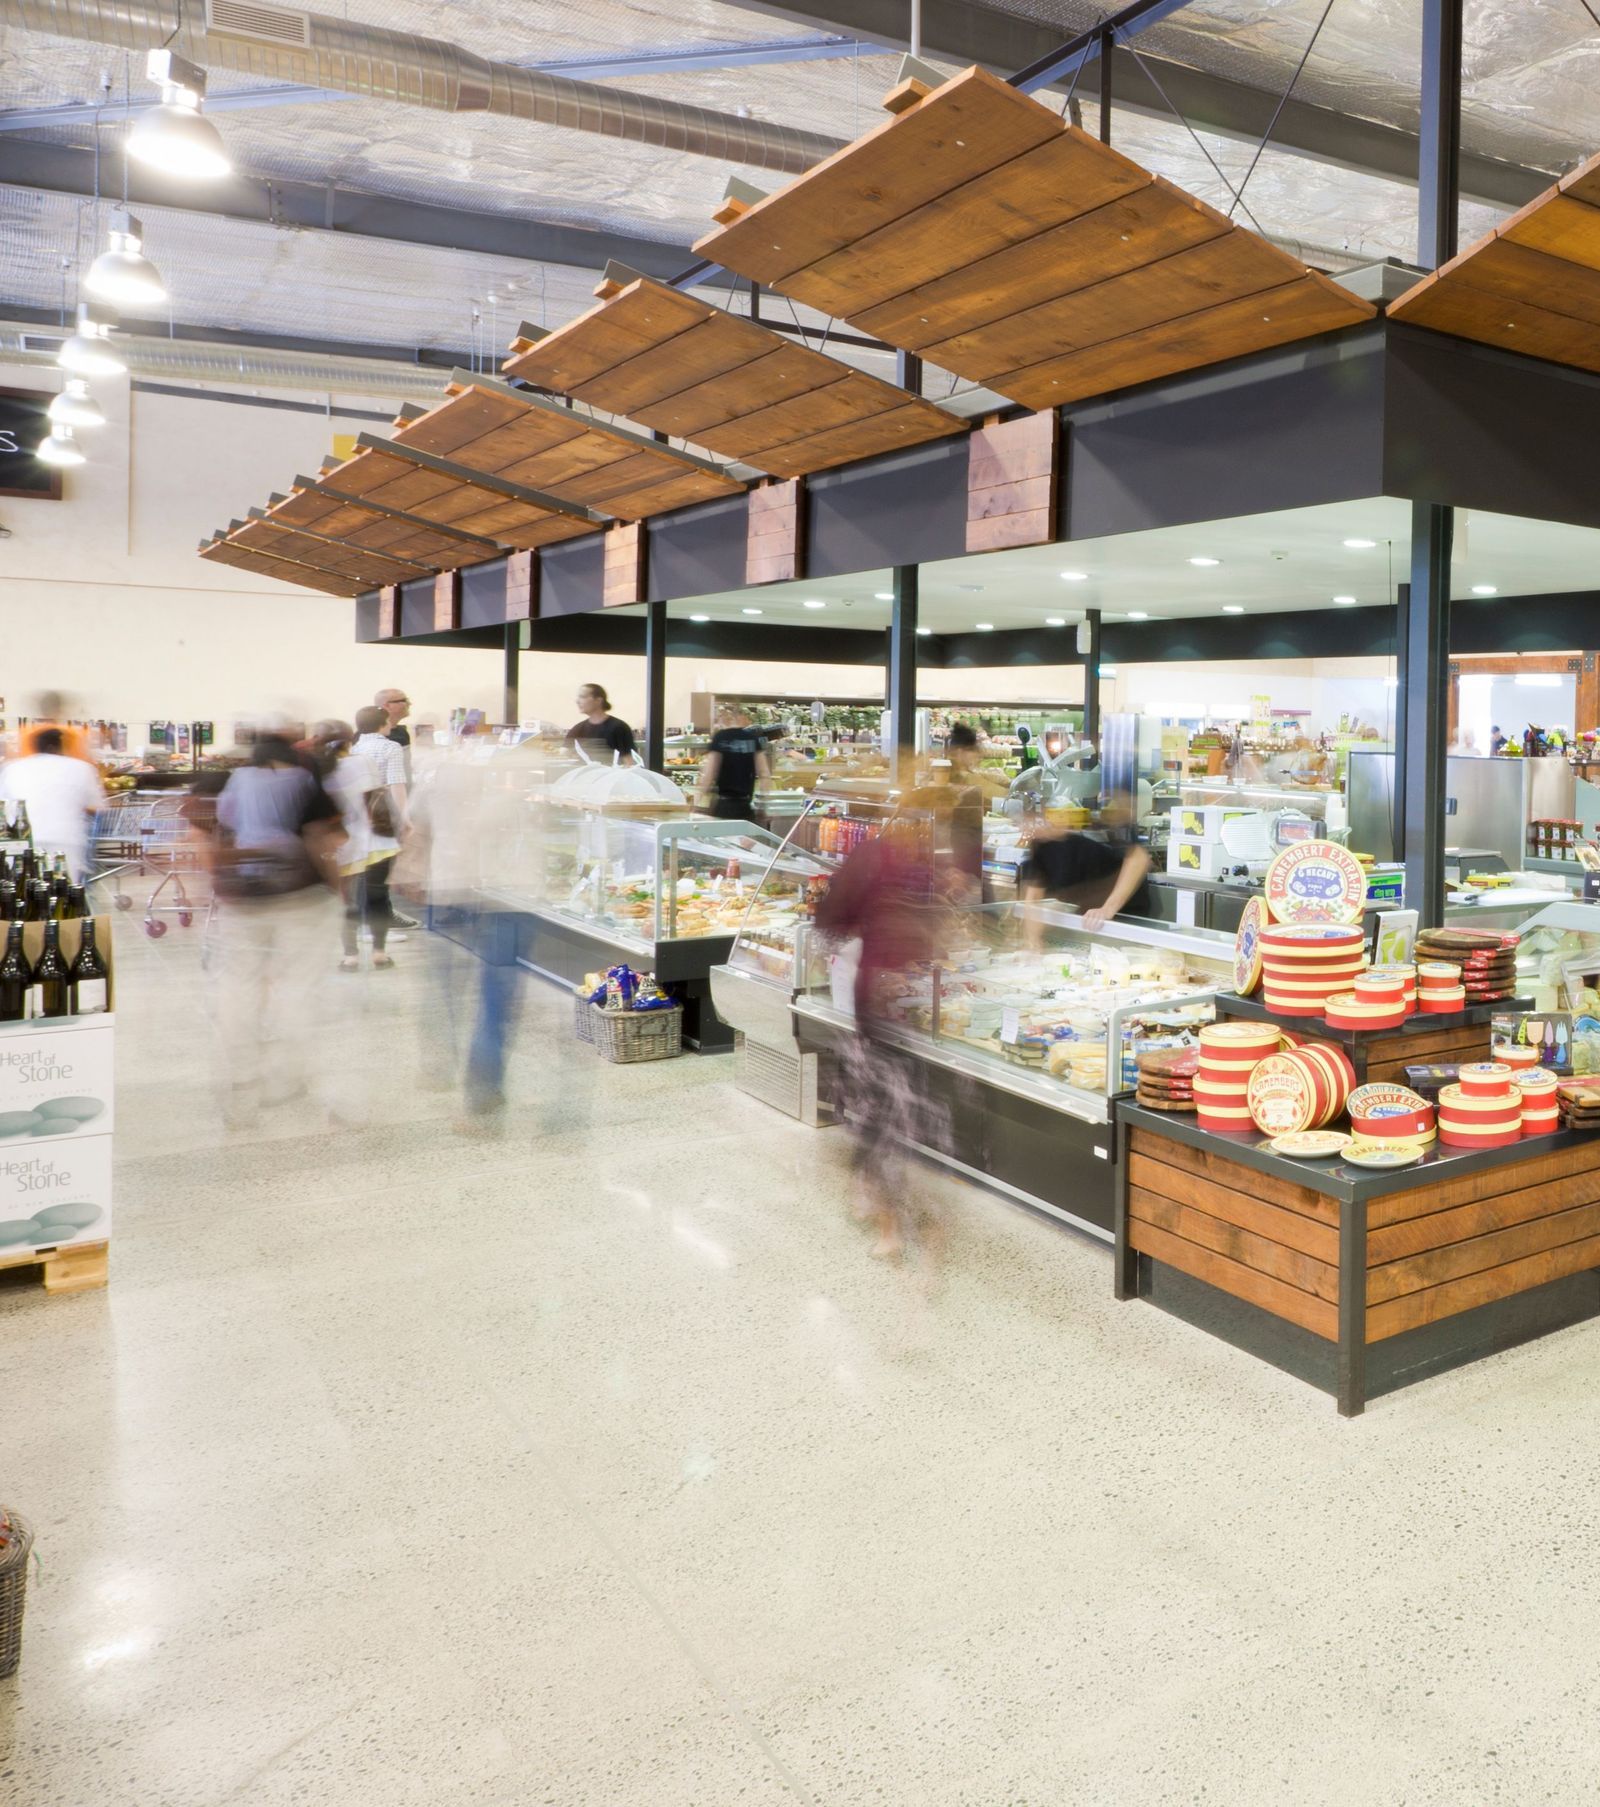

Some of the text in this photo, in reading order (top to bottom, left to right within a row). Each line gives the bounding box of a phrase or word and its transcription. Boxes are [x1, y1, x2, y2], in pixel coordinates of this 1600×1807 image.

[1271, 845, 1326, 892] CAMEMBERT
[0, 1050, 42, 1067] Heart
[18, 1064, 73, 1084] Stone
[16, 1171, 71, 1193] Stone
